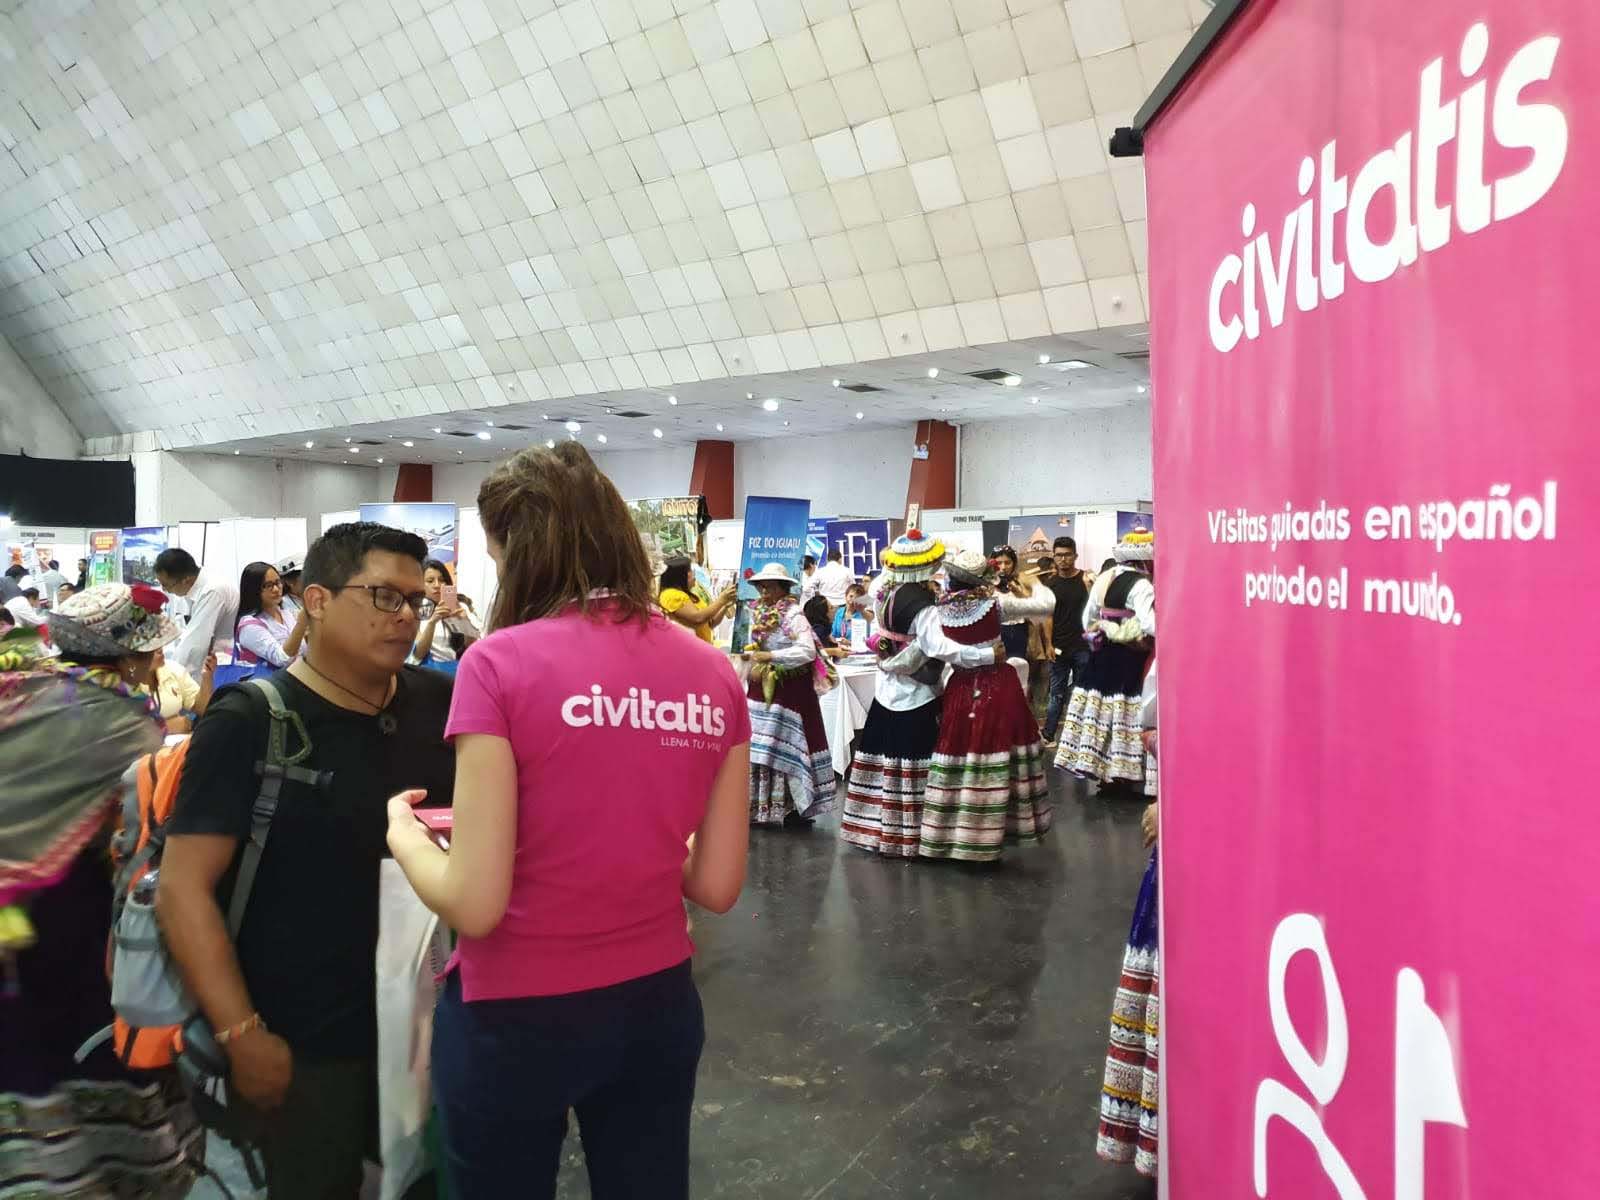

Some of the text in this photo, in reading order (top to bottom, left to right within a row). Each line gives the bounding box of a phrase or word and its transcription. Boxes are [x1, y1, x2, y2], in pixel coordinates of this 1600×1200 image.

[1208, 21, 1568, 353] civitatis
[1208, 481, 1557, 553] Visitas guiadas en español
[1245, 565, 1462, 626] por todo el mundo.
[560, 684, 726, 737] civitatis
[661, 736, 690, 748] LLENA
[693, 739, 705, 750] TU
